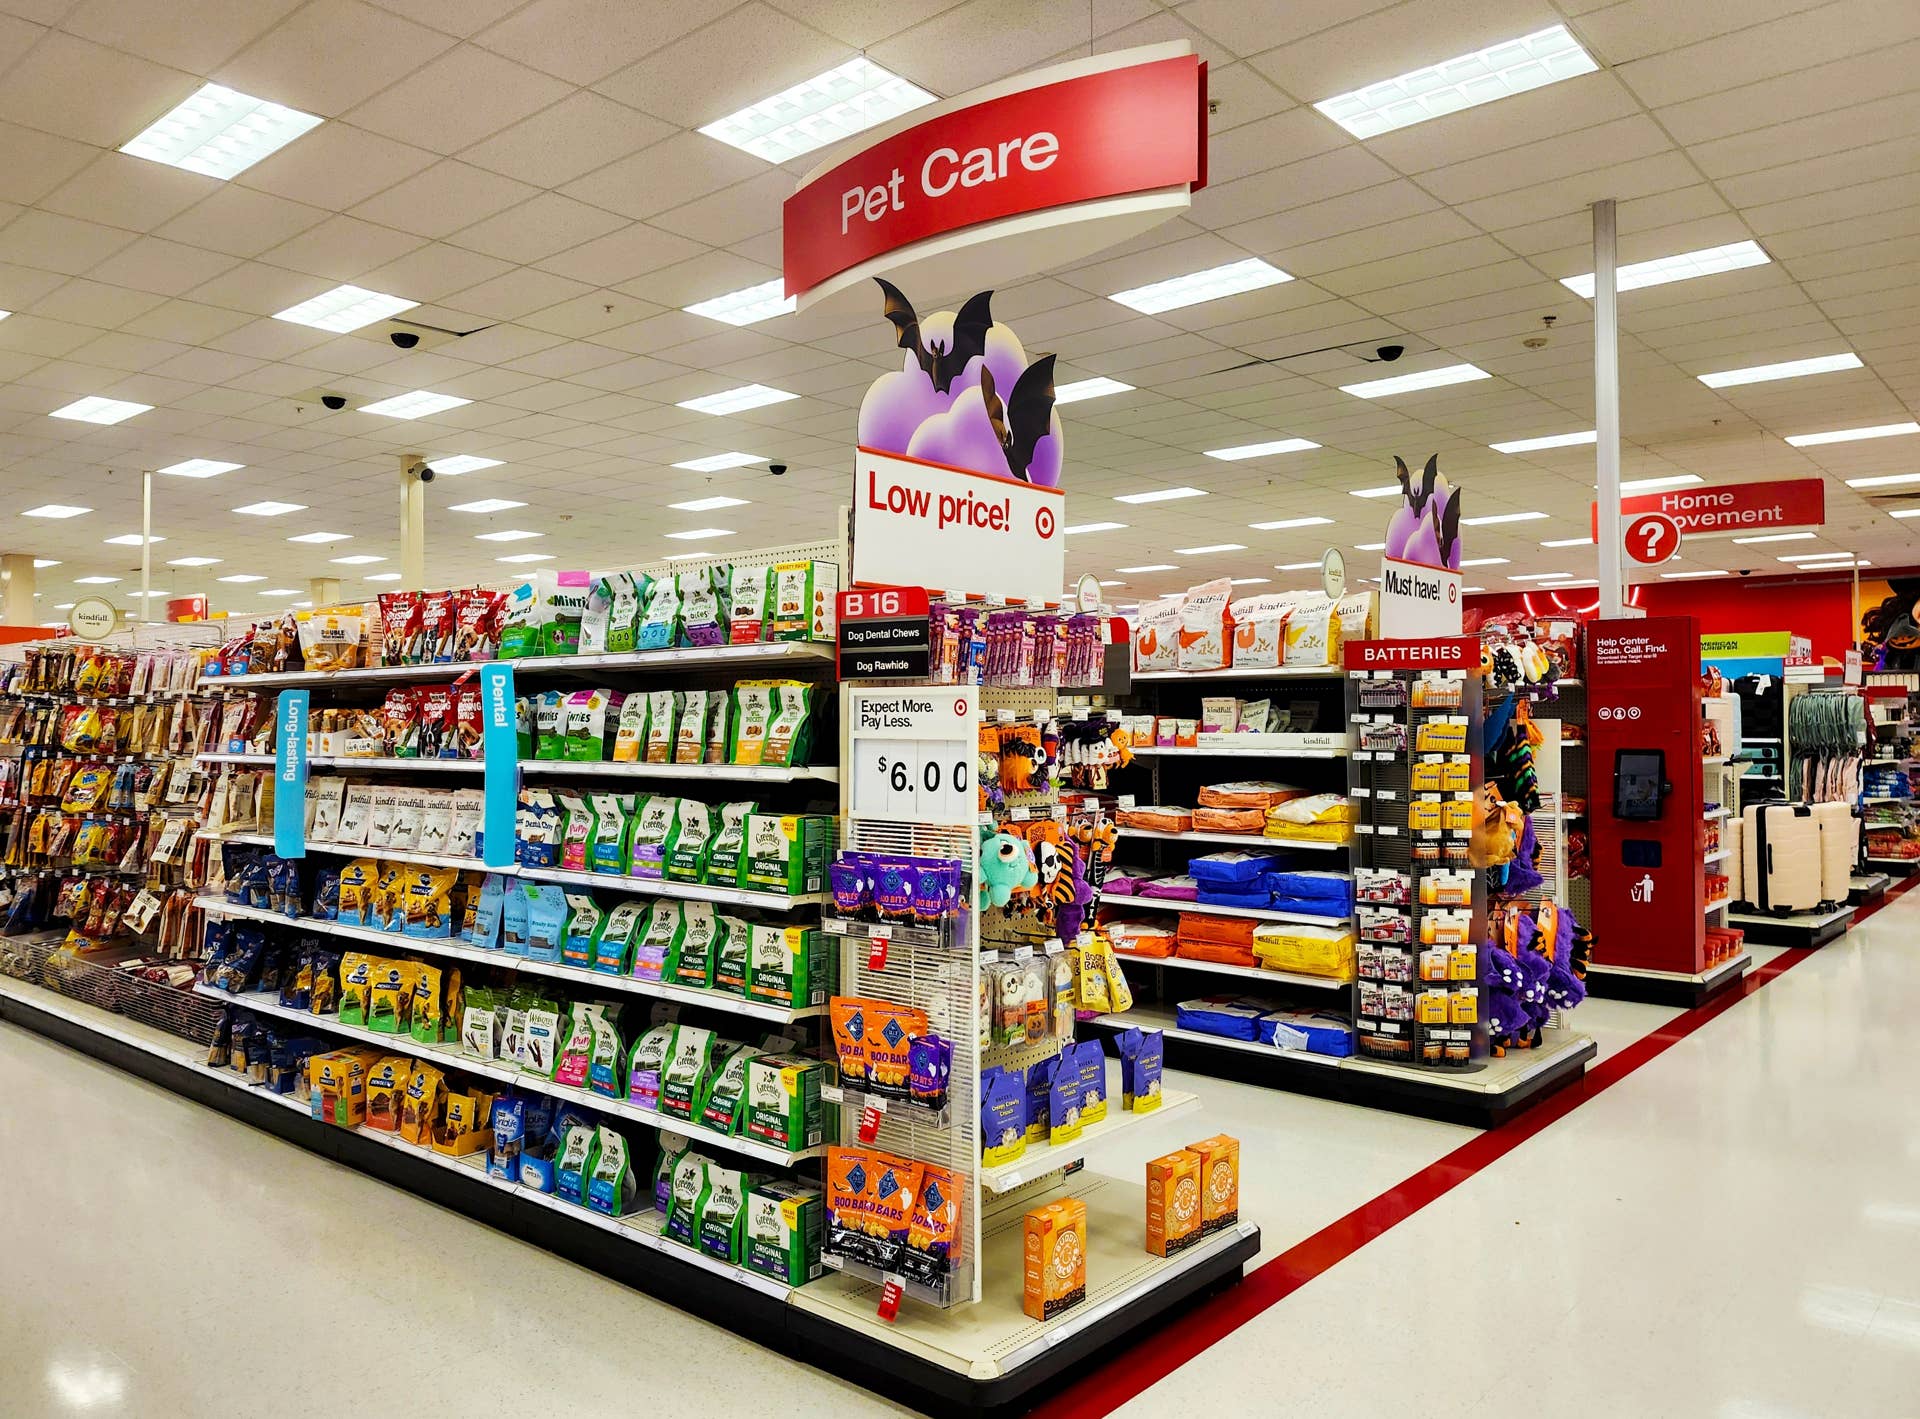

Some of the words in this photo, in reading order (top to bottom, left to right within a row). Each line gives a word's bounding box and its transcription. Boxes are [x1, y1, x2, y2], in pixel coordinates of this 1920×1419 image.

[841, 168, 905, 235] Pet
[921, 131, 1059, 197] Care
[869, 471, 931, 517] Low
[939, 489, 1010, 532] price!
[1662, 493, 1734, 511] Home
[1673, 505, 1783, 528] ovement
[1385, 570, 1412, 596] Must
[1415, 576, 1440, 601] have!
[846, 594, 864, 616] B
[870, 591, 899, 614] 16
[1336, 605, 1365, 617] ndfull.
[848, 631, 864, 642] Dog
[866, 629, 891, 639] Dental
[892, 629, 920, 638] Chews
[1597, 638, 1617, 647] Help
[1619, 637, 1649, 645] Center
[1364, 646, 1462, 661] BATTERIES
[1597, 647, 1621, 655] Scan.
[1646, 644, 1667, 653] Find.
[857, 661, 872, 672] Dog
[874, 660, 909, 670] Rawhide
[1796, 657, 1812, 665] 24
[492, 675, 508, 727] Dental
[861, 700, 899, 715] Expect
[902, 699, 933, 713] More.
[861, 715, 881, 730] Pay
[884, 715, 912, 727] Less.
[283, 700, 301, 781] Long-lasting
[755, 833, 781, 846] Greenies
[755, 861, 781, 872] ORIGINAL
[759, 945, 784, 959] Greenies
[758, 973, 786, 985] ORIGINAL
[871, 1051, 889, 1062] BOO
[757, 1083, 781, 1098] Greenies
[756, 1111, 782, 1126] ORIGINAL
[713, 1193, 739, 1209] Greenies
[834, 1196, 850, 1208] BOO
[876, 1204, 904, 1221] BARS
[755, 1215, 781, 1232] Greenies
[1056, 1233, 1077, 1252] BUDDY
[755, 1243, 783, 1260] ORIGINAL
